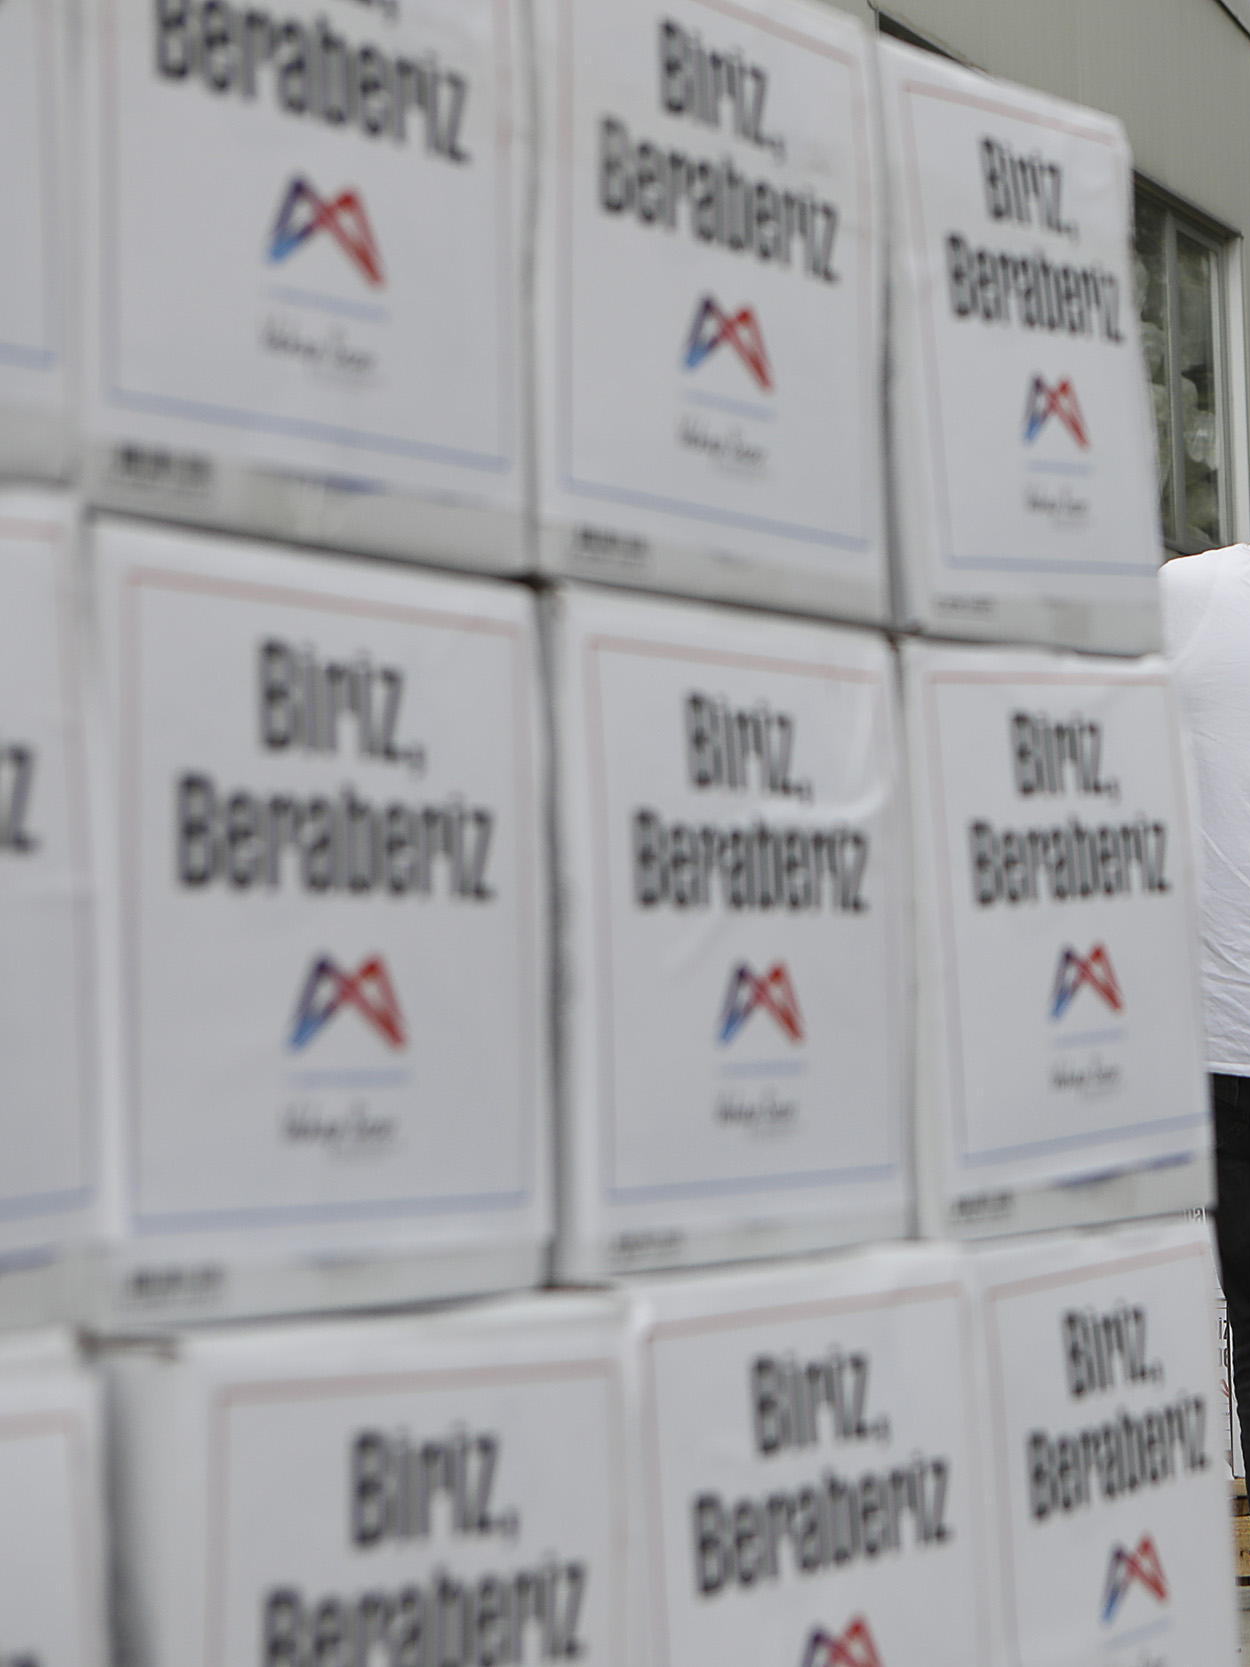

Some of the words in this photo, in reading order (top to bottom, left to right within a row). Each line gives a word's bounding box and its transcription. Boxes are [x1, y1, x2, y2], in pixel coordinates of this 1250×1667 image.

[658, 17, 786, 163] Biriz,
[600, 114, 841, 286] Beraberiz
[979, 135, 1079, 241] Biriz,
[945, 231, 1125, 345] Beraberiz
[258, 637, 425, 781] Biriz,
[685, 690, 815, 801] Biriz,
[1010, 709, 1120, 800] Biriz,
[175, 766, 497, 905] Beraberiz
[633, 808, 868, 913] Beraberiz
[968, 811, 1173, 908] Beraberiz
[749, 1341, 890, 1457] Biriz,
[1061, 1299, 1164, 1398] Biriz,
[349, 1420, 520, 1553] Biriz,
[1025, 1393, 1209, 1522] Beraberiz
[690, 1453, 953, 1604] Beraberiz
[261, 1553, 590, 1667] Beraberiz
